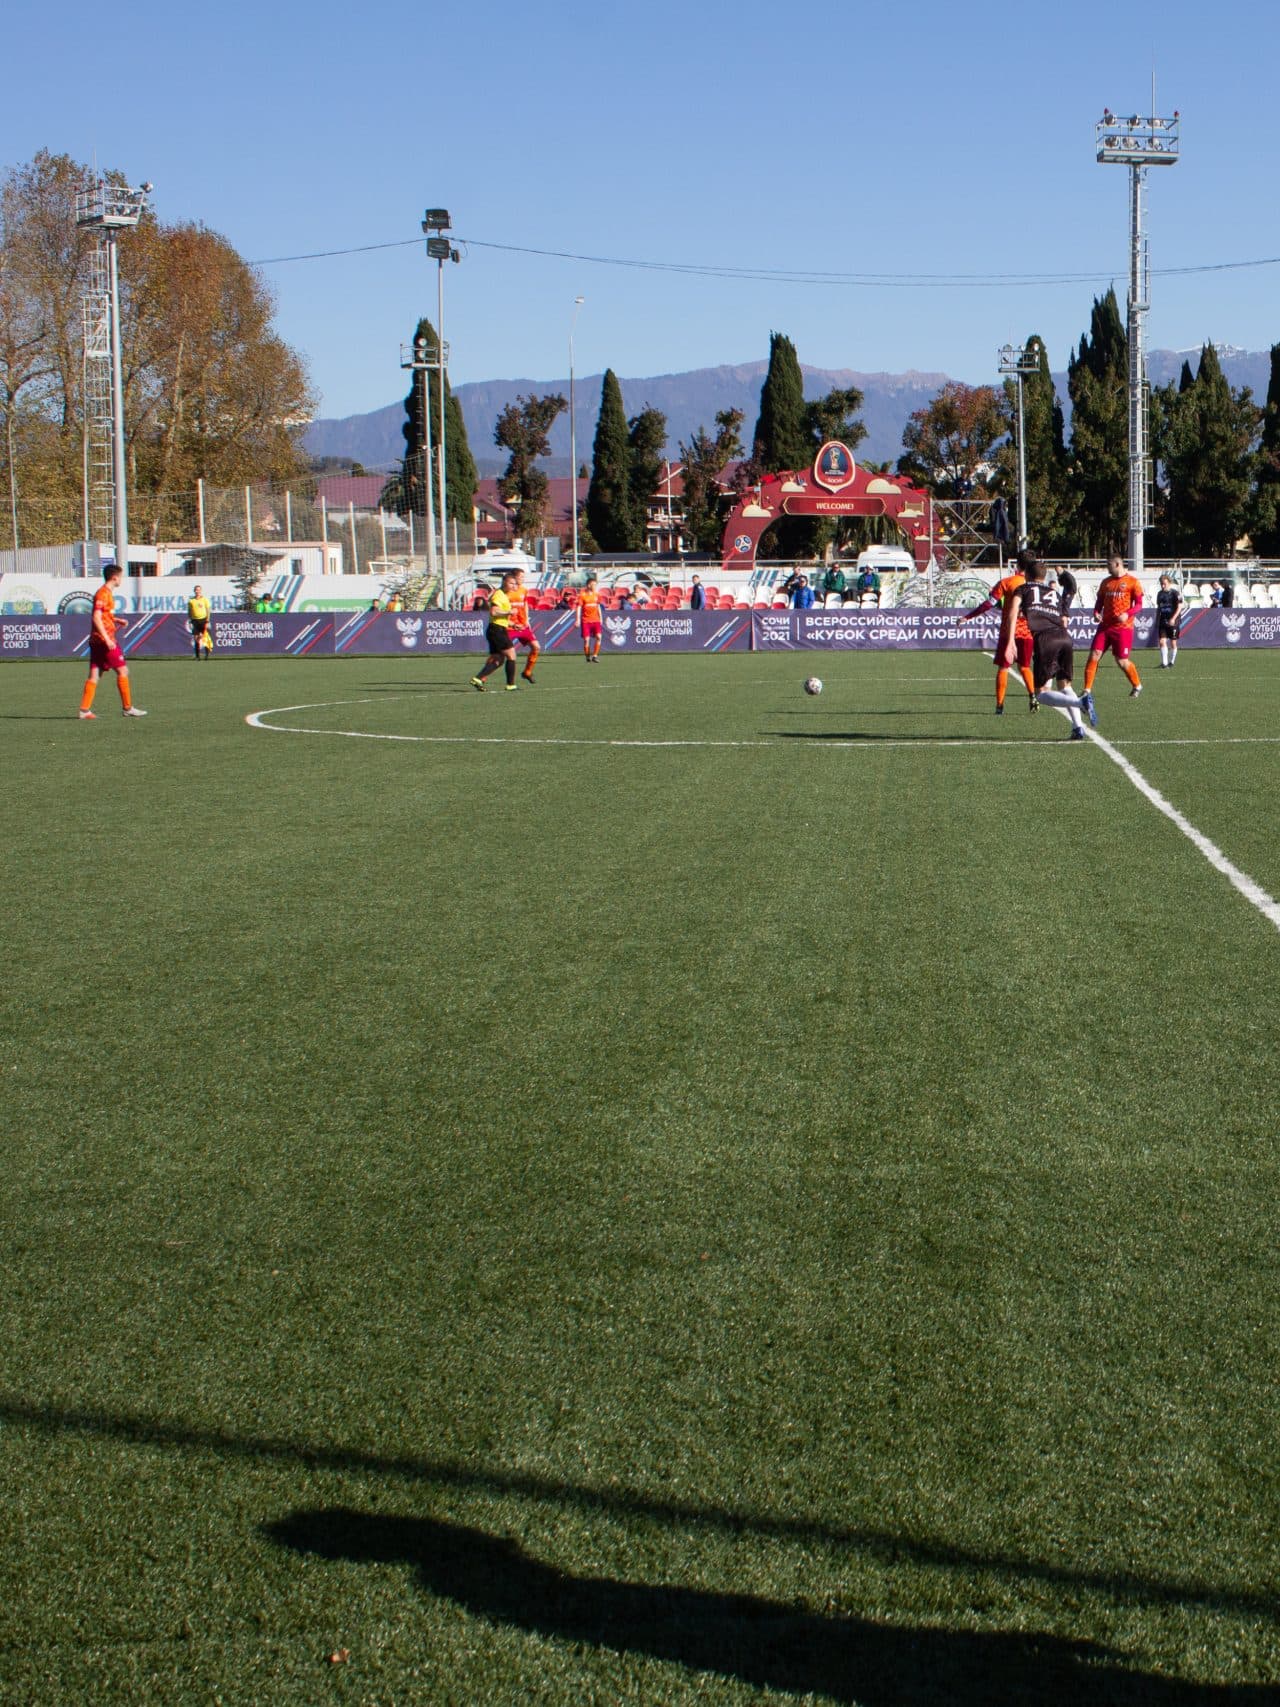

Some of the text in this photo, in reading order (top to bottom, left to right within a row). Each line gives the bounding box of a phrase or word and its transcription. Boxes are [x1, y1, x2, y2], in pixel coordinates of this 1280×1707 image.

[1031, 586, 1059, 608] 14
[426, 620, 483, 628] РОССИЙСКИЙ
[635, 618, 692, 627] РОССИЙСКИЙ
[762, 617, 790, 625] СОЧИ
[806, 615, 1099, 626] ВСЕРОССИЙСКИЕ СОРЕНОВА УТБО
[3, 623, 60, 632] РОССИЙСКИЙ
[216, 622, 273, 630] РОССИЙСКИЙ
[216, 630, 273, 638] ФУТБОЛЬНЫЙ
[426, 628, 483, 636] ФУТБОЛЬНЫЙ
[635, 627, 692, 636] ФУТБОЛЬНЫЙ
[762, 631, 790, 640] 2021
[869, 629, 919, 641] СРЕДИ
[922, 629, 1000, 639] ЛЮБИТЕЛЬ
[3, 632, 60, 640] ФУТБОЛЬНЫЙ
[636, 636, 661, 644] СОЮЗ
[1250, 632, 1274, 640] СОЮЗ
[216, 639, 242, 647] СОЮЗ
[427, 637, 452, 645] СОЮЗ
